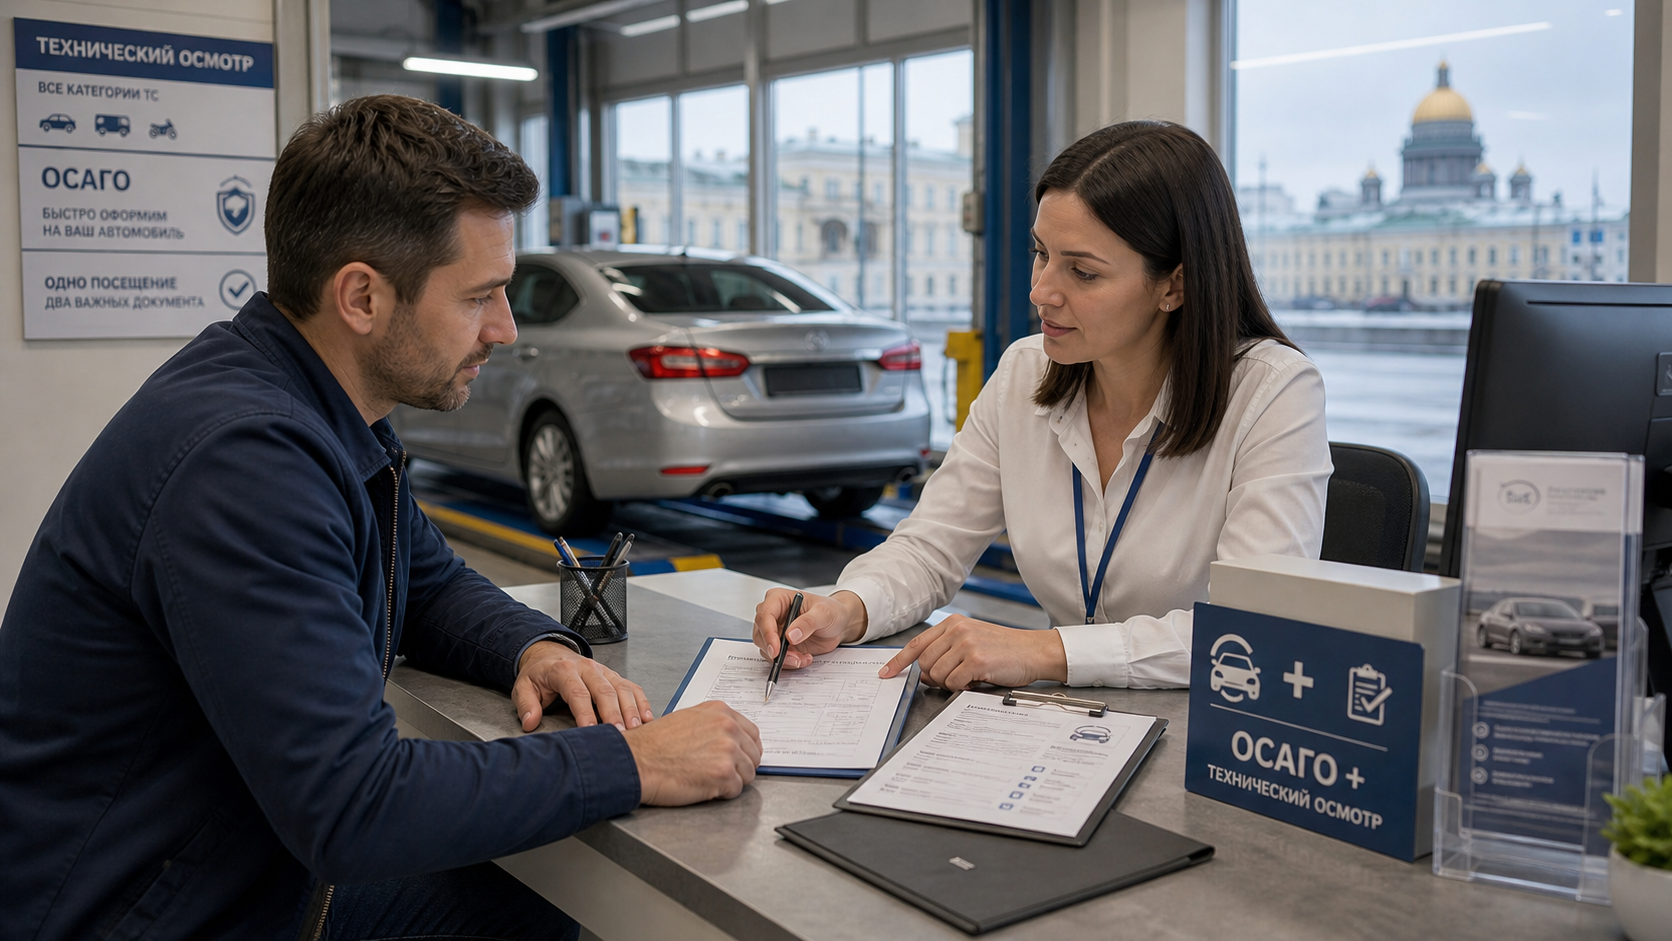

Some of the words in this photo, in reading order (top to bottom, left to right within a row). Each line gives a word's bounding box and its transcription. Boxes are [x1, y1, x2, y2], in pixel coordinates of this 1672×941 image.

[36, 36, 175, 66] ТЕХНИЧЕСКИЙ
[179, 50, 254, 72] ОСМОТР
[38, 81, 63, 95] ВСЕ
[67, 83, 140, 101] КАТЕГОРИИ
[144, 89, 159, 102] ТС
[42, 167, 131, 191] ОСАГО
[43, 207, 96, 221] БЫСТРО
[100, 209, 167, 222] ОФОРМИМ
[43, 225, 61, 237] НА
[65, 226, 95, 238] ВАШ
[98, 226, 185, 240] АВТОМОБИЛЬ
[45, 276, 87, 292] ОДНО
[91, 277, 178, 291] ПОСЕЩЕНИЕ
[45, 296, 71, 310] ДВА
[75, 296, 130, 309] ВАЖНЫХ
[132, 296, 205, 310] ДОКУМЕНТА
[1231, 730, 1338, 786] ОСАГО
[1207, 763, 1310, 809] ТЕХНИЧЕСКИЙ
[1314, 797, 1383, 829] ОСМОТР
